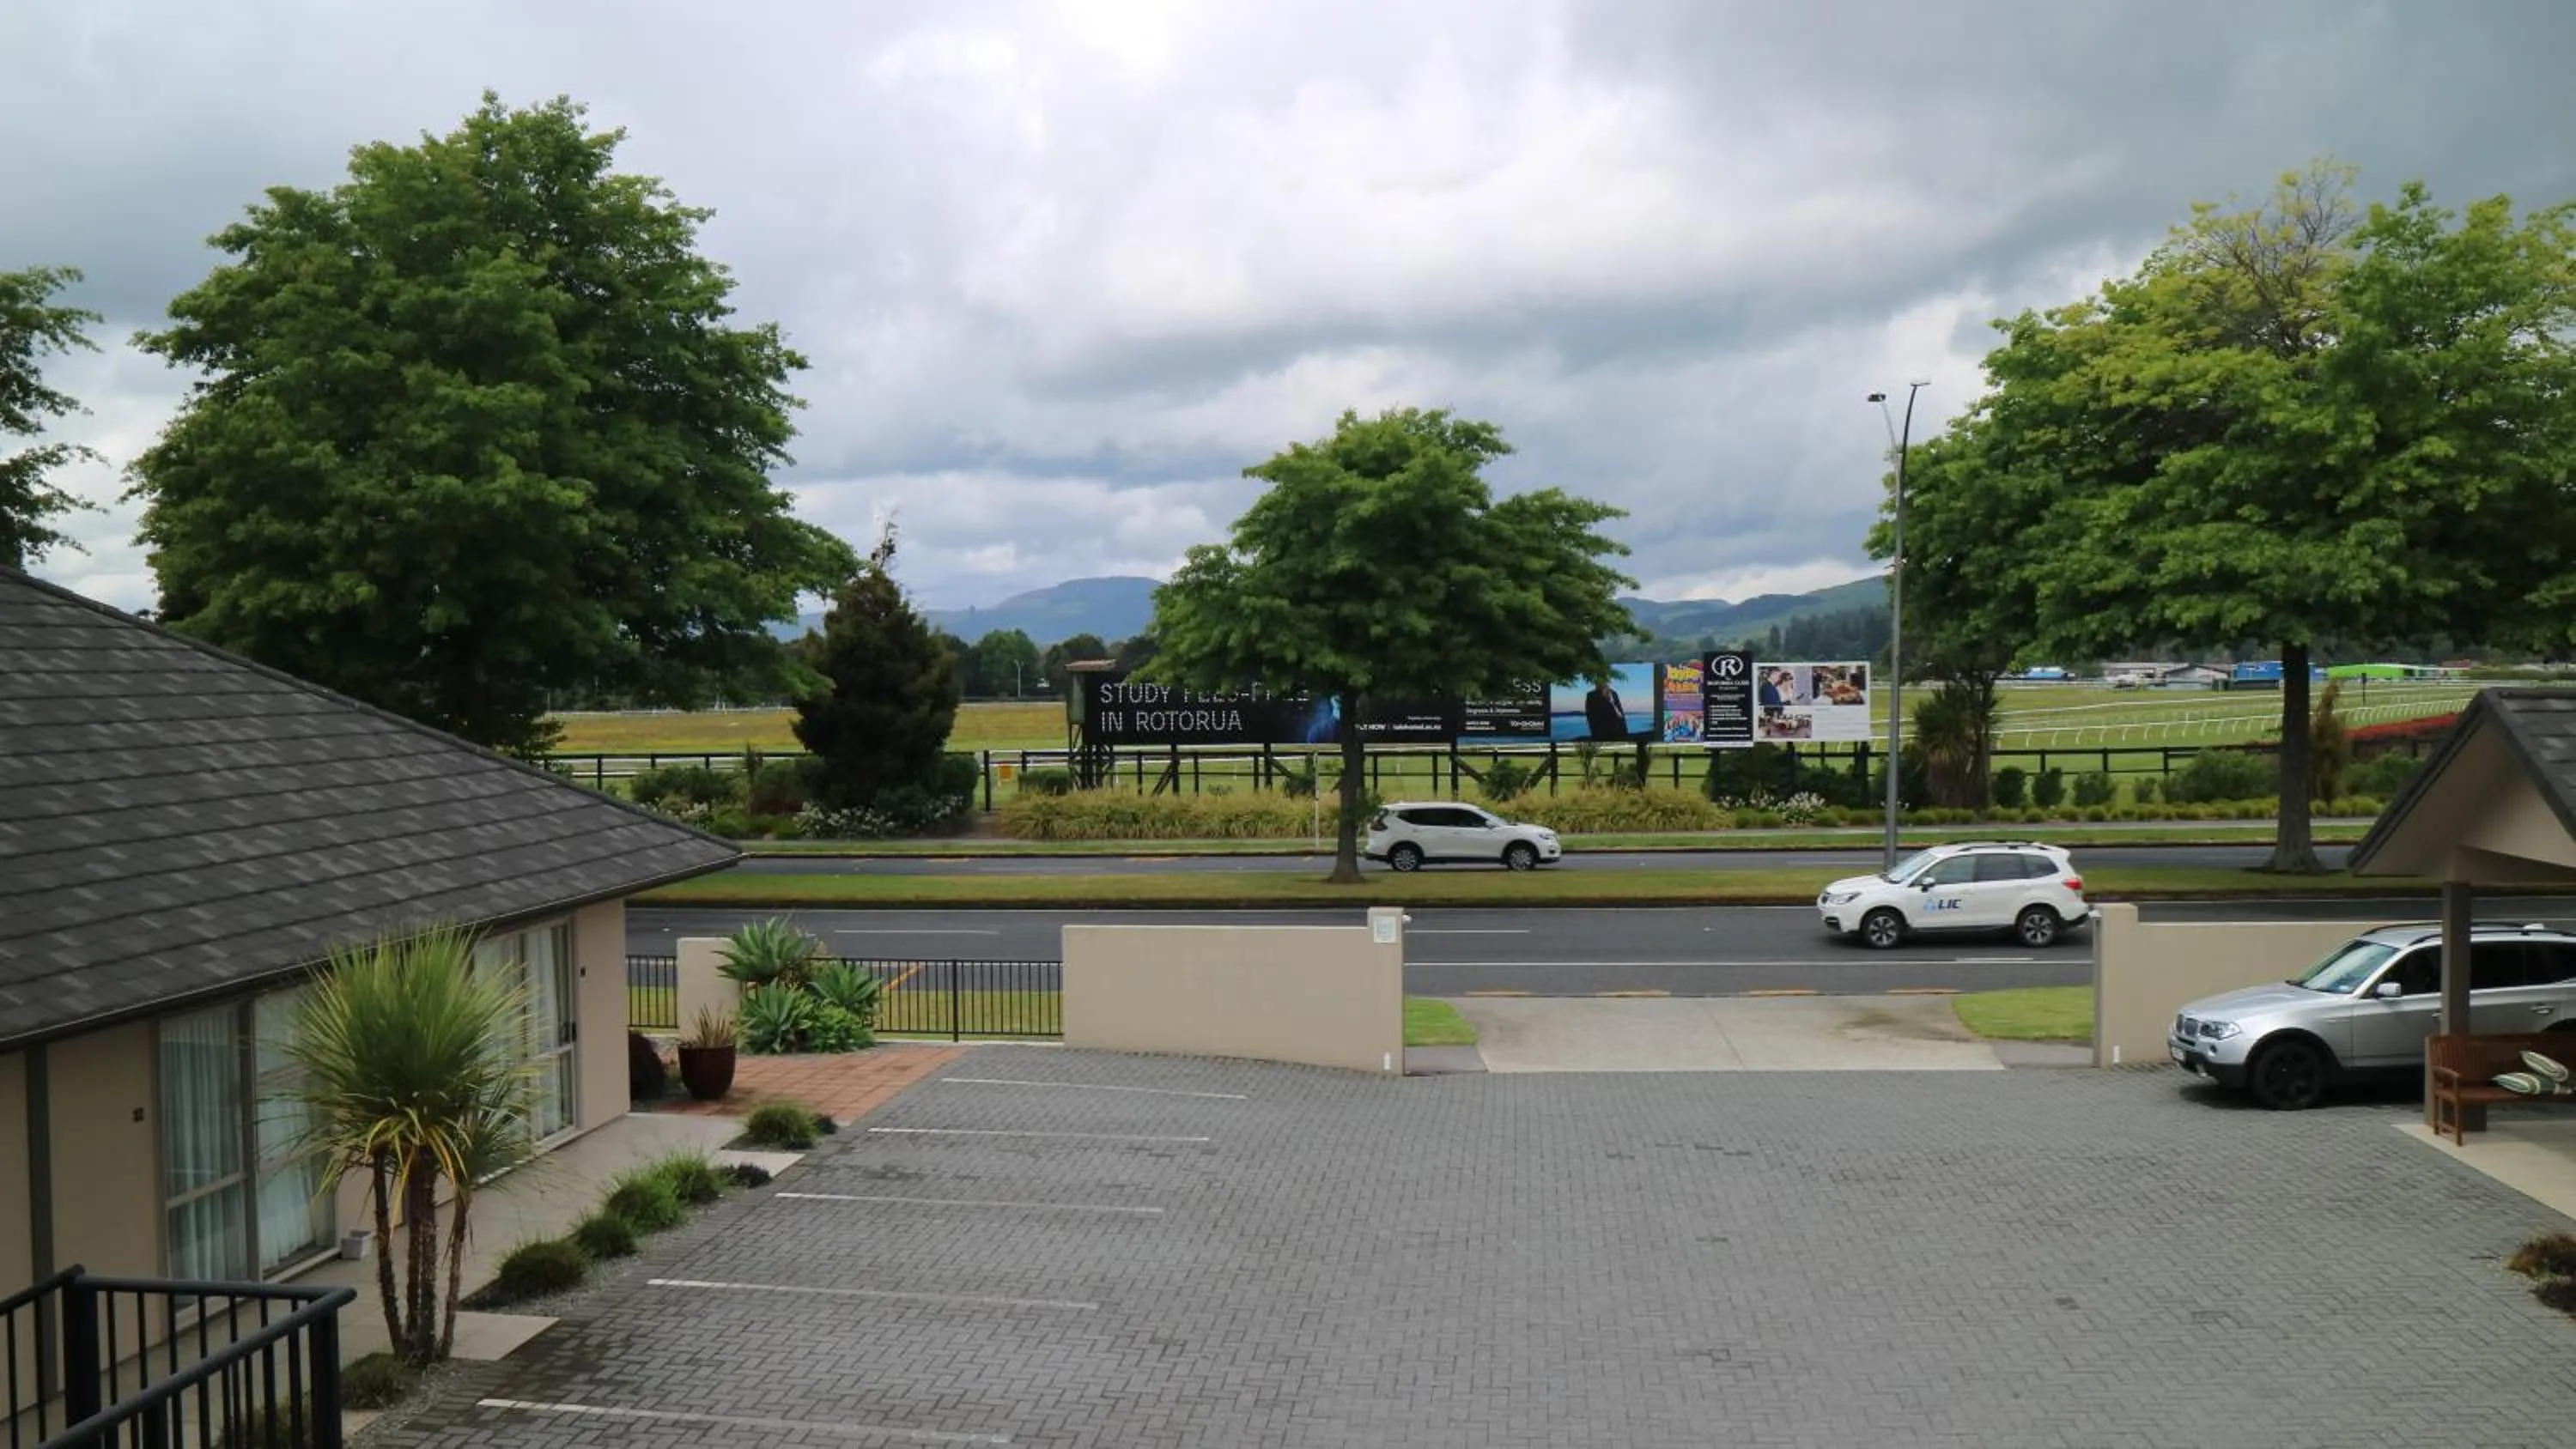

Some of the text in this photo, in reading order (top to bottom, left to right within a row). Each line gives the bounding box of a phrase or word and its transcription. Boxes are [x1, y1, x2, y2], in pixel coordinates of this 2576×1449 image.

[1100, 682, 1170, 703] STUDY
[1101, 710, 1243, 731] IN ROTORUA
